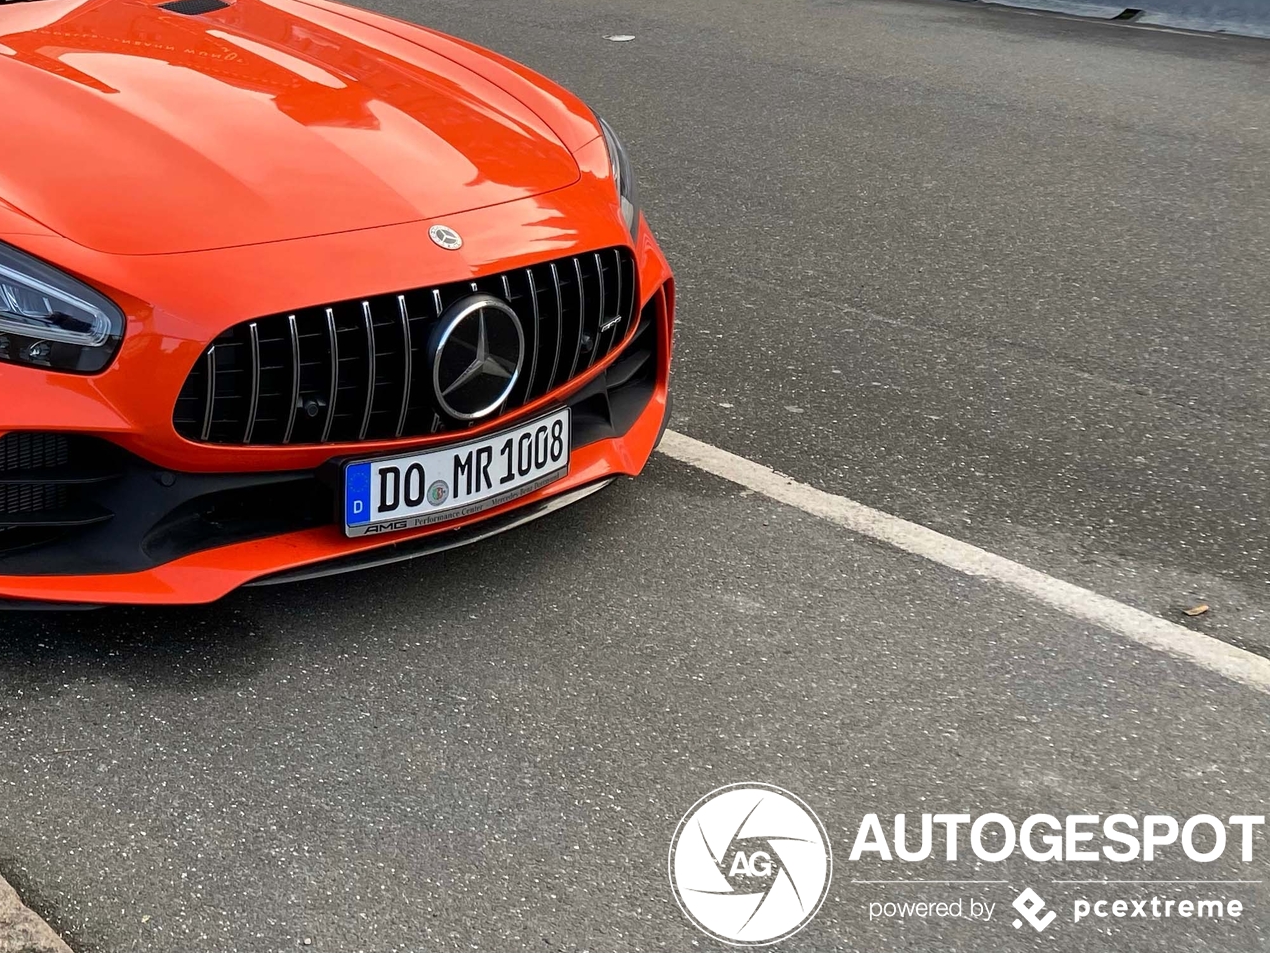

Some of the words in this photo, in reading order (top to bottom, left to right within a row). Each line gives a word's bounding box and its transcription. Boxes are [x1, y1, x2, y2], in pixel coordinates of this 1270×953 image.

[377, 462, 425, 513] DO
[453, 445, 492, 499] MR
[499, 419, 563, 485] 1008
[353, 500, 363, 514] D
[363, 520, 407, 535] AMG
[414, 509, 460, 526] Performance
[461, 504, 483, 515] Center
